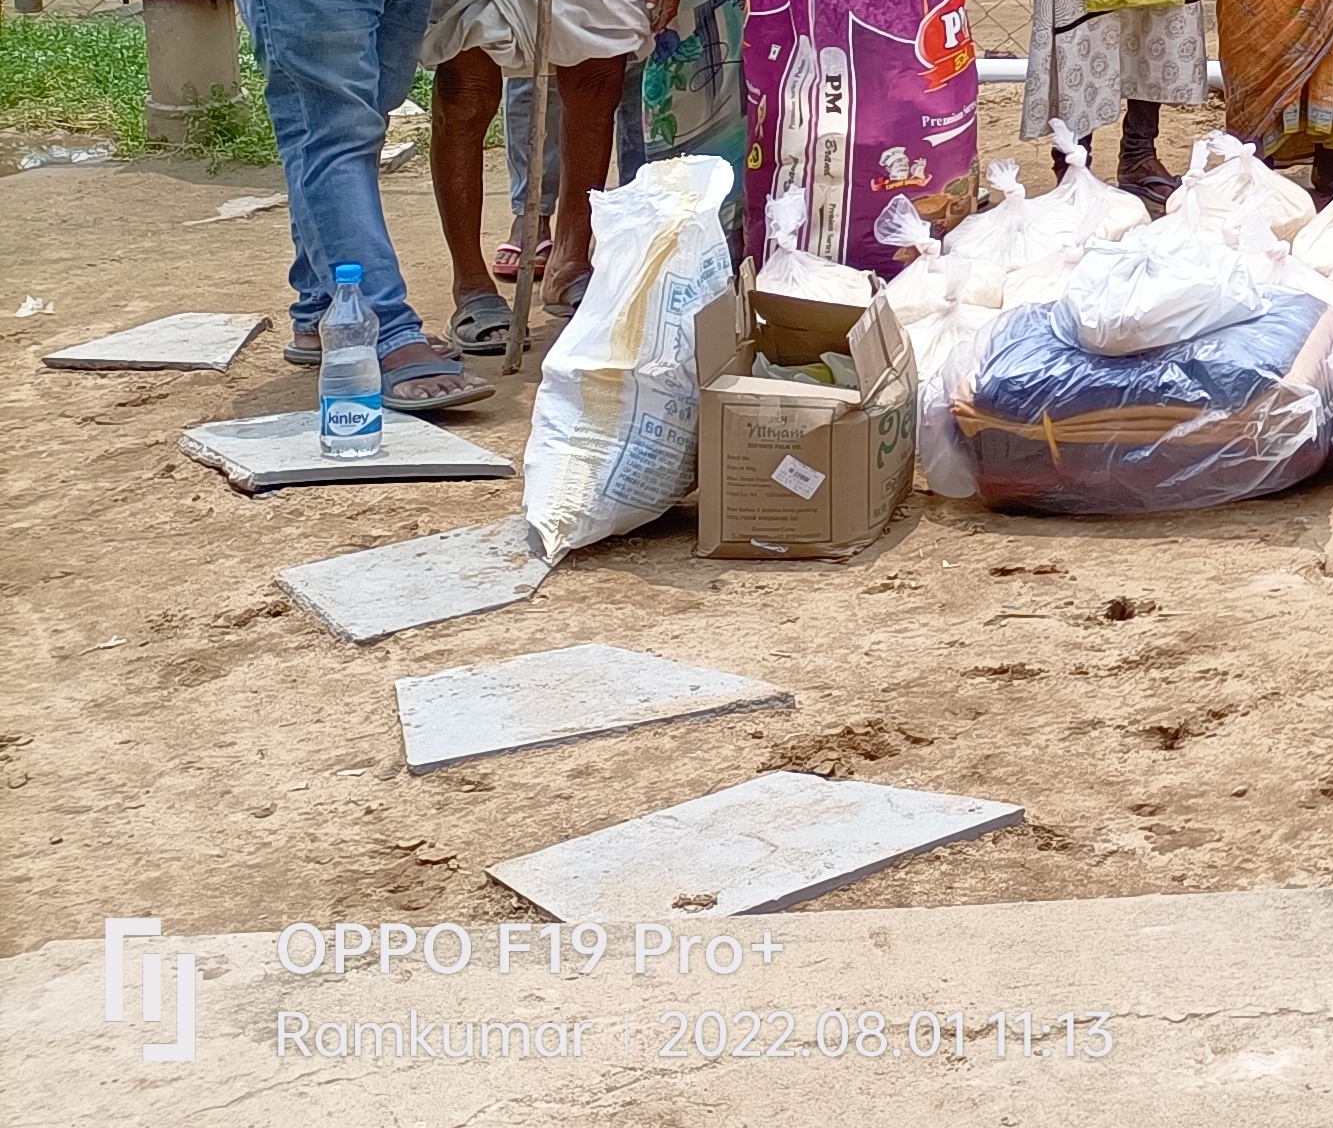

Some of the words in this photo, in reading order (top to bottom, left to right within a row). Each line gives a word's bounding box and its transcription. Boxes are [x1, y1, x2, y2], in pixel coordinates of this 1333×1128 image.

[824, 74, 841, 114] PM
[824, 139, 837, 179] Brand
[328, 412, 369, 425] kinley
[645, 421, 663, 437] 60
